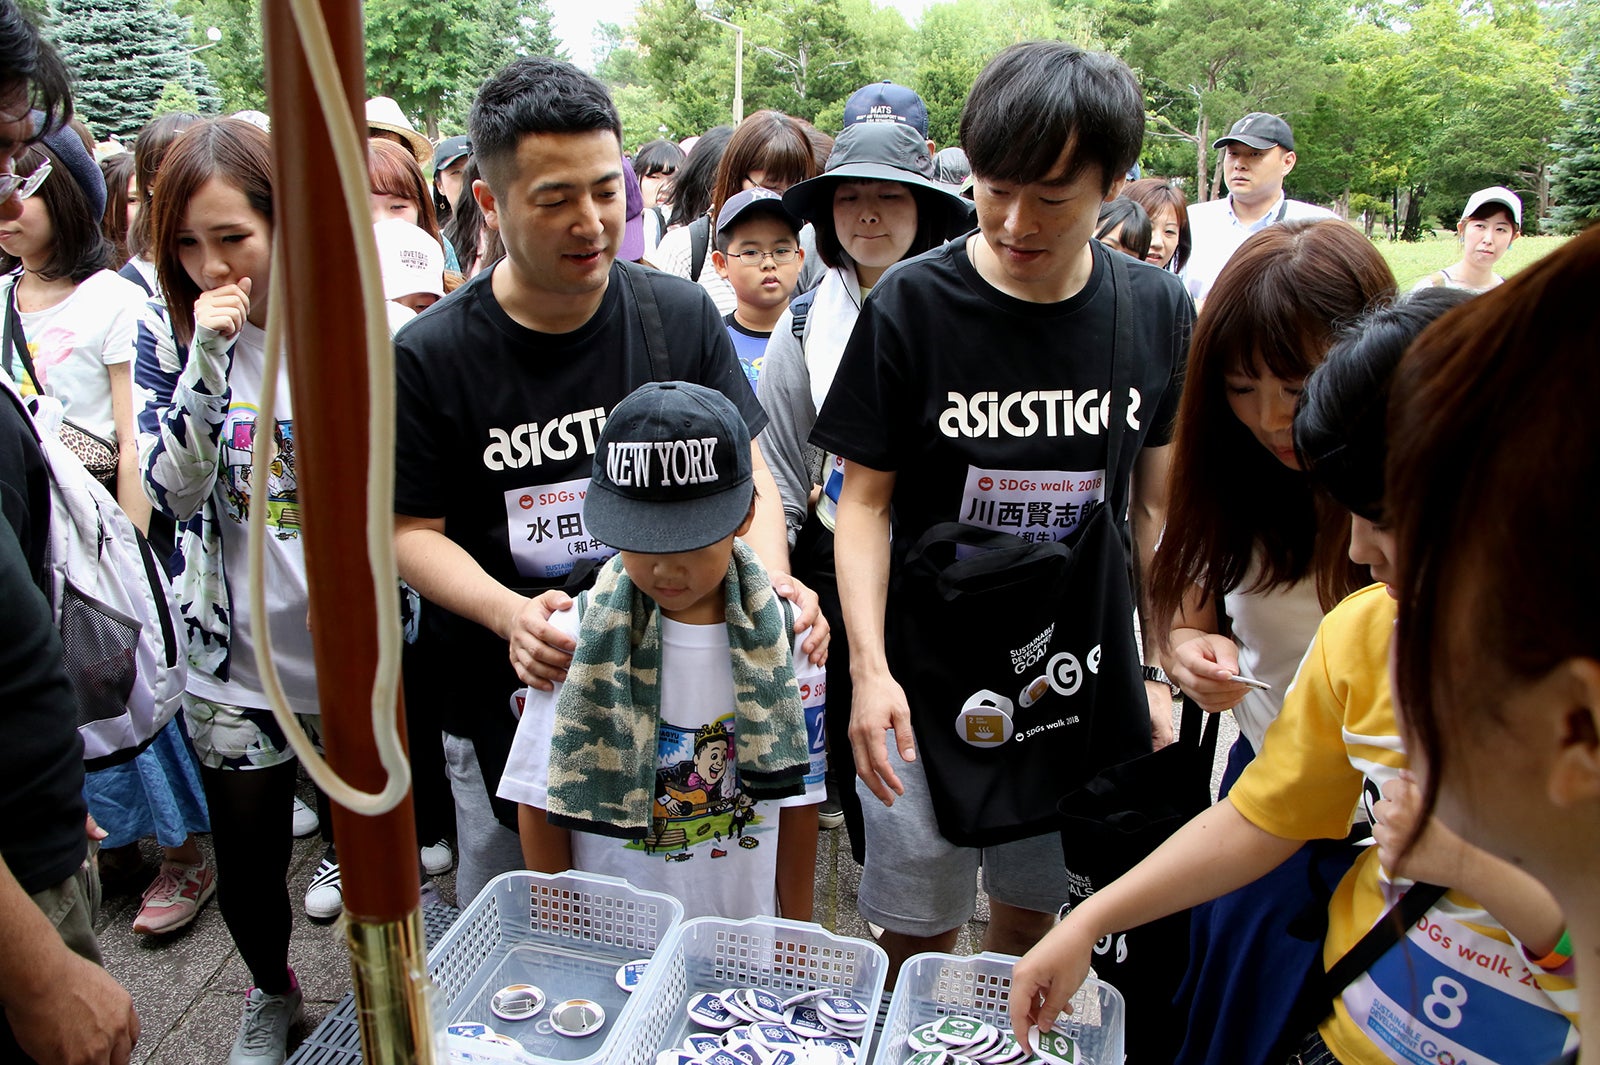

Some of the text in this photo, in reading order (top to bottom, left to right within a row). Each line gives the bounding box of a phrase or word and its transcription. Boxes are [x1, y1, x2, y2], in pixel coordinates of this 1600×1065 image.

[870, 105, 892, 114] MATS
[606, 437, 719, 487] NEW YORK
[539, 491, 575, 507] SDGs
[998, 476, 1102, 493] SDGs walk 2018
[526, 513, 584, 544] 水田
[1025, 715, 1080, 739] SDGs walk 2018
[1416, 915, 1452, 949] DGs
[1458, 943, 1513, 978] walk
[1372, 998, 1421, 1041] SUSTAINABLE
[1422, 975, 1468, 1029] 8
[1369, 1006, 1418, 1049] DEVELOPMENT
